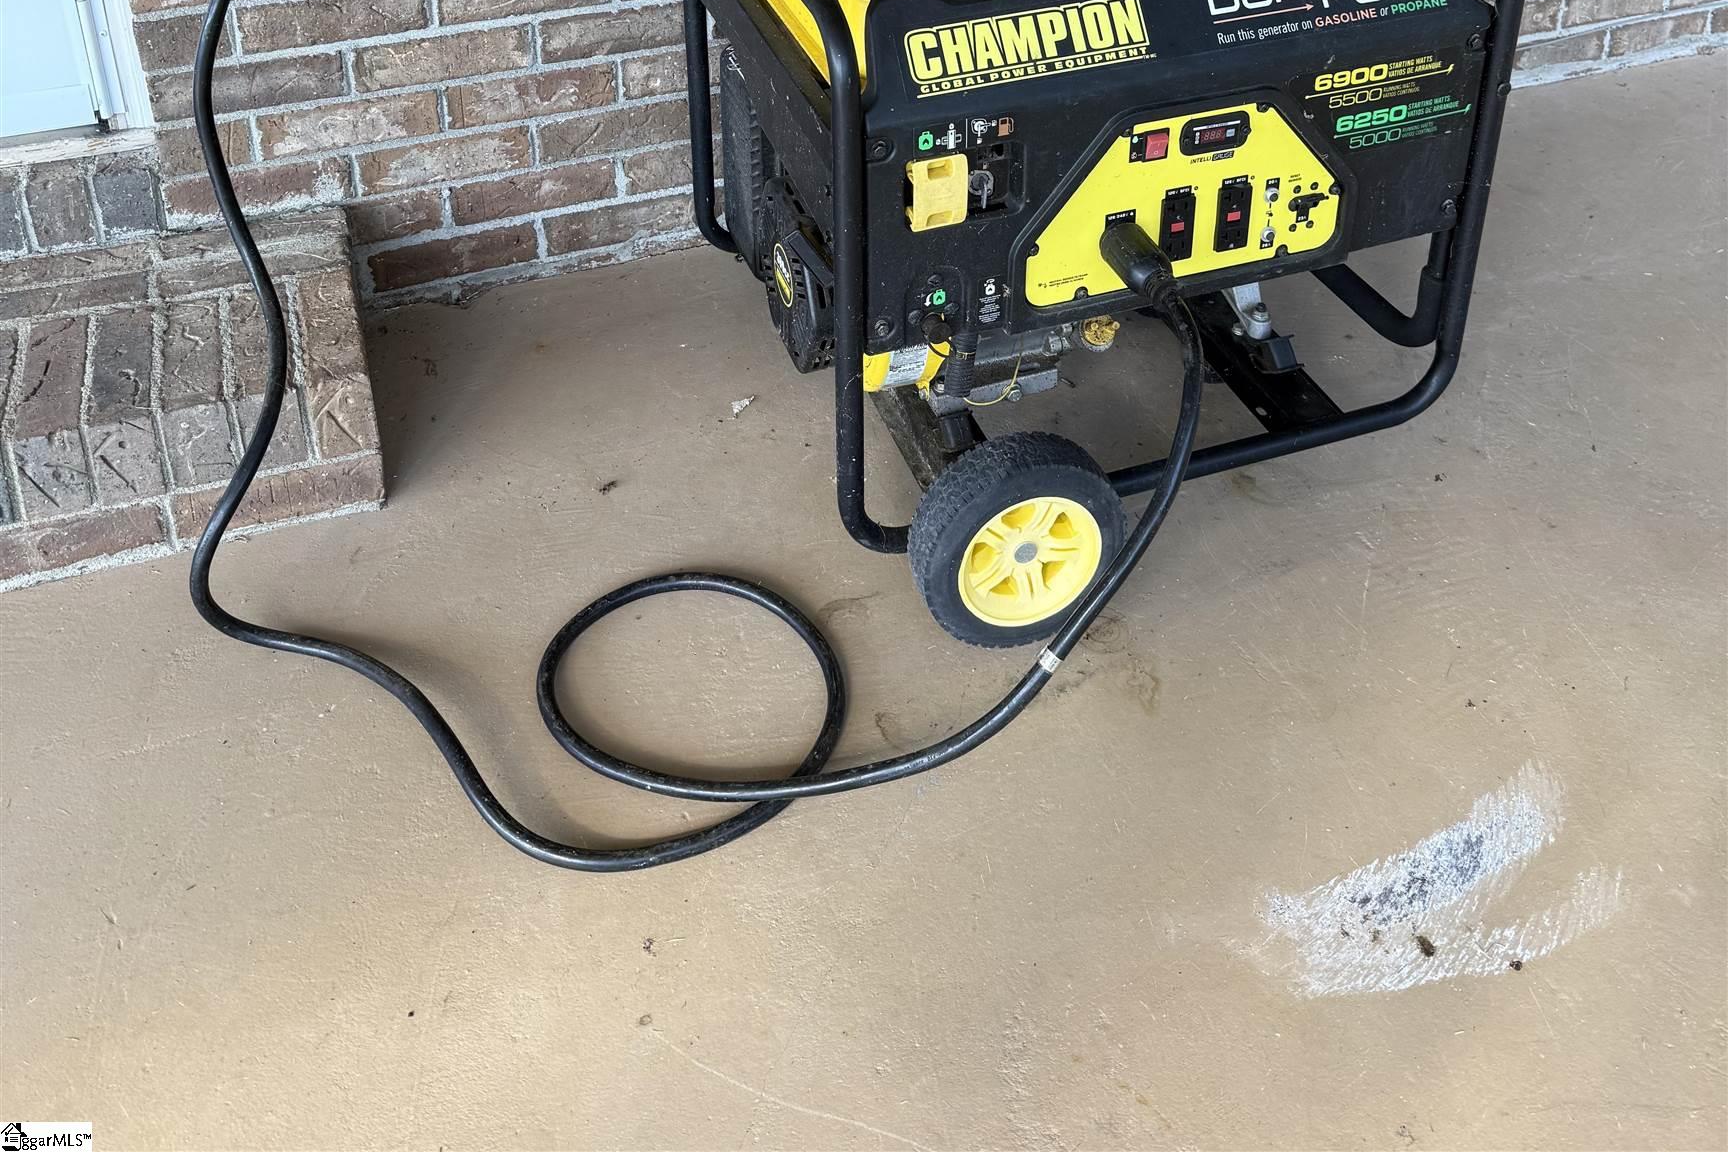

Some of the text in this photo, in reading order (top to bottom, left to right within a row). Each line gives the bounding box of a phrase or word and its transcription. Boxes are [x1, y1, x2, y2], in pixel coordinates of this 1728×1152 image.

[1217, 32, 1236, 45] Run
[1237, 27, 1256, 41] this
[1257, 21, 1300, 40] generator
[1301, 19, 1313, 30] on
[1315, 7, 1378, 28] GASOLINE
[1379, 6, 1389, 17] or
[920, 47, 1147, 94] GLOBAL POWER EQUIPMENT
[1388, 55, 1433, 70] STARTING WATTS
[1314, 63, 1389, 92] 6900
[1328, 87, 1383, 109] 5500
[1407, 94, 1451, 110] STARTING WATTS
[1335, 104, 1408, 133] 6250
[1349, 127, 1401, 149] 5000
